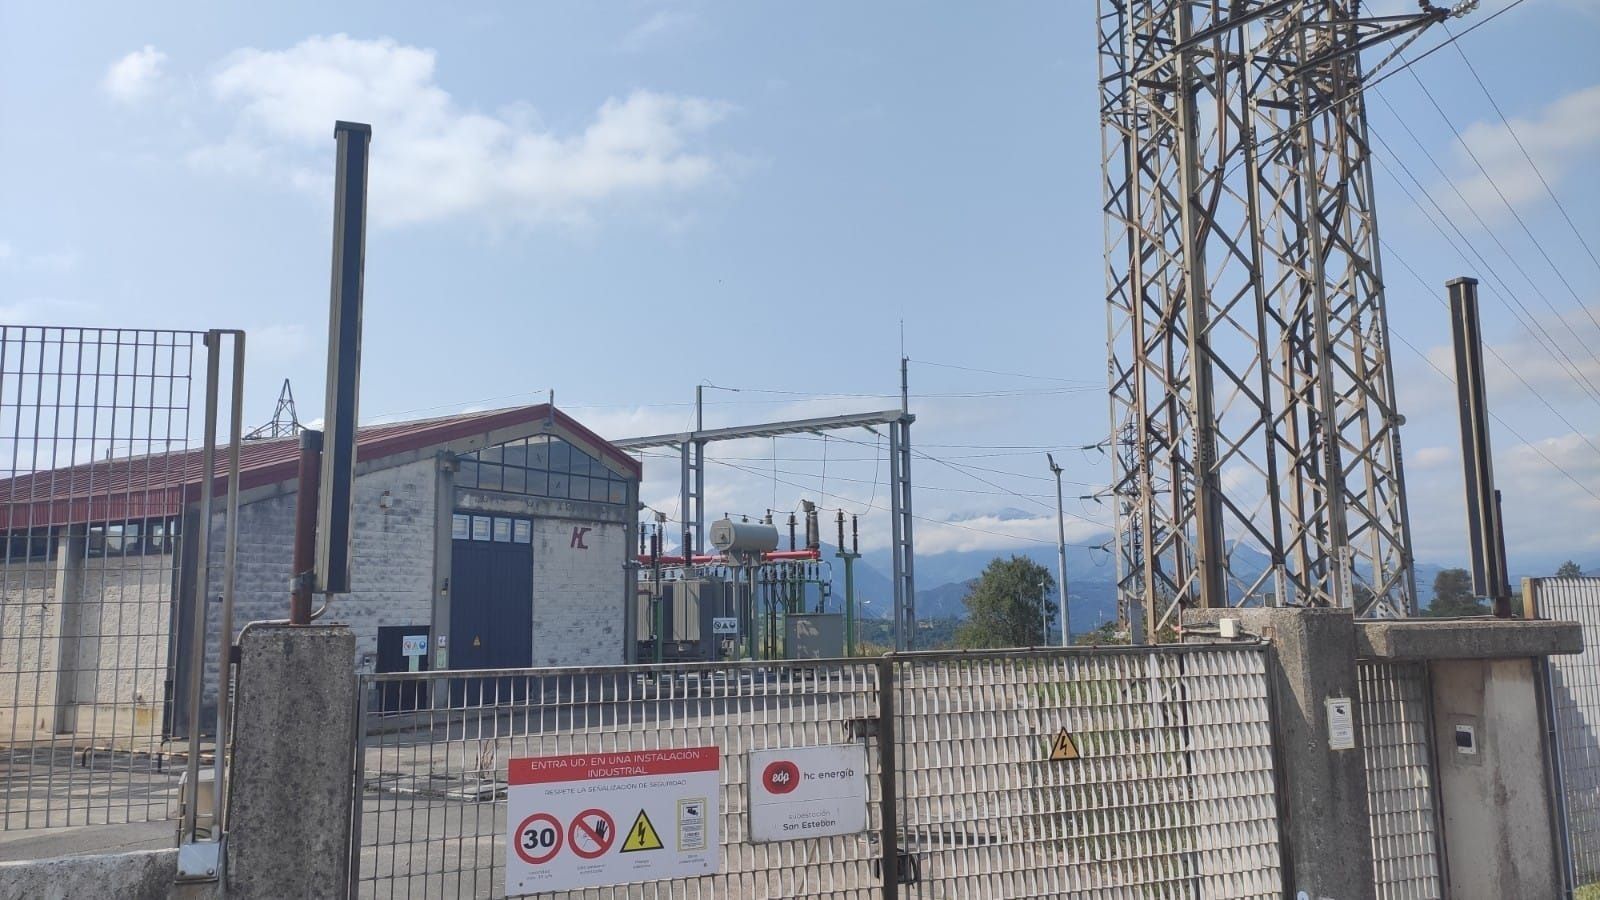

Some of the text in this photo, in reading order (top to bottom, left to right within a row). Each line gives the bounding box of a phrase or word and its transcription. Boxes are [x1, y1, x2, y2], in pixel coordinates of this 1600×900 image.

[531, 750, 700, 770] ENTRA UD. EN UNA INSTALACIÓN
[587, 766, 648, 778] INDUSTRIAL
[772, 770, 789, 785] edp
[804, 767, 854, 780] hc energía
[544, 788, 575, 796] RESPETE
[783, 823, 799, 831] San
[523, 828, 555, 850] 30
